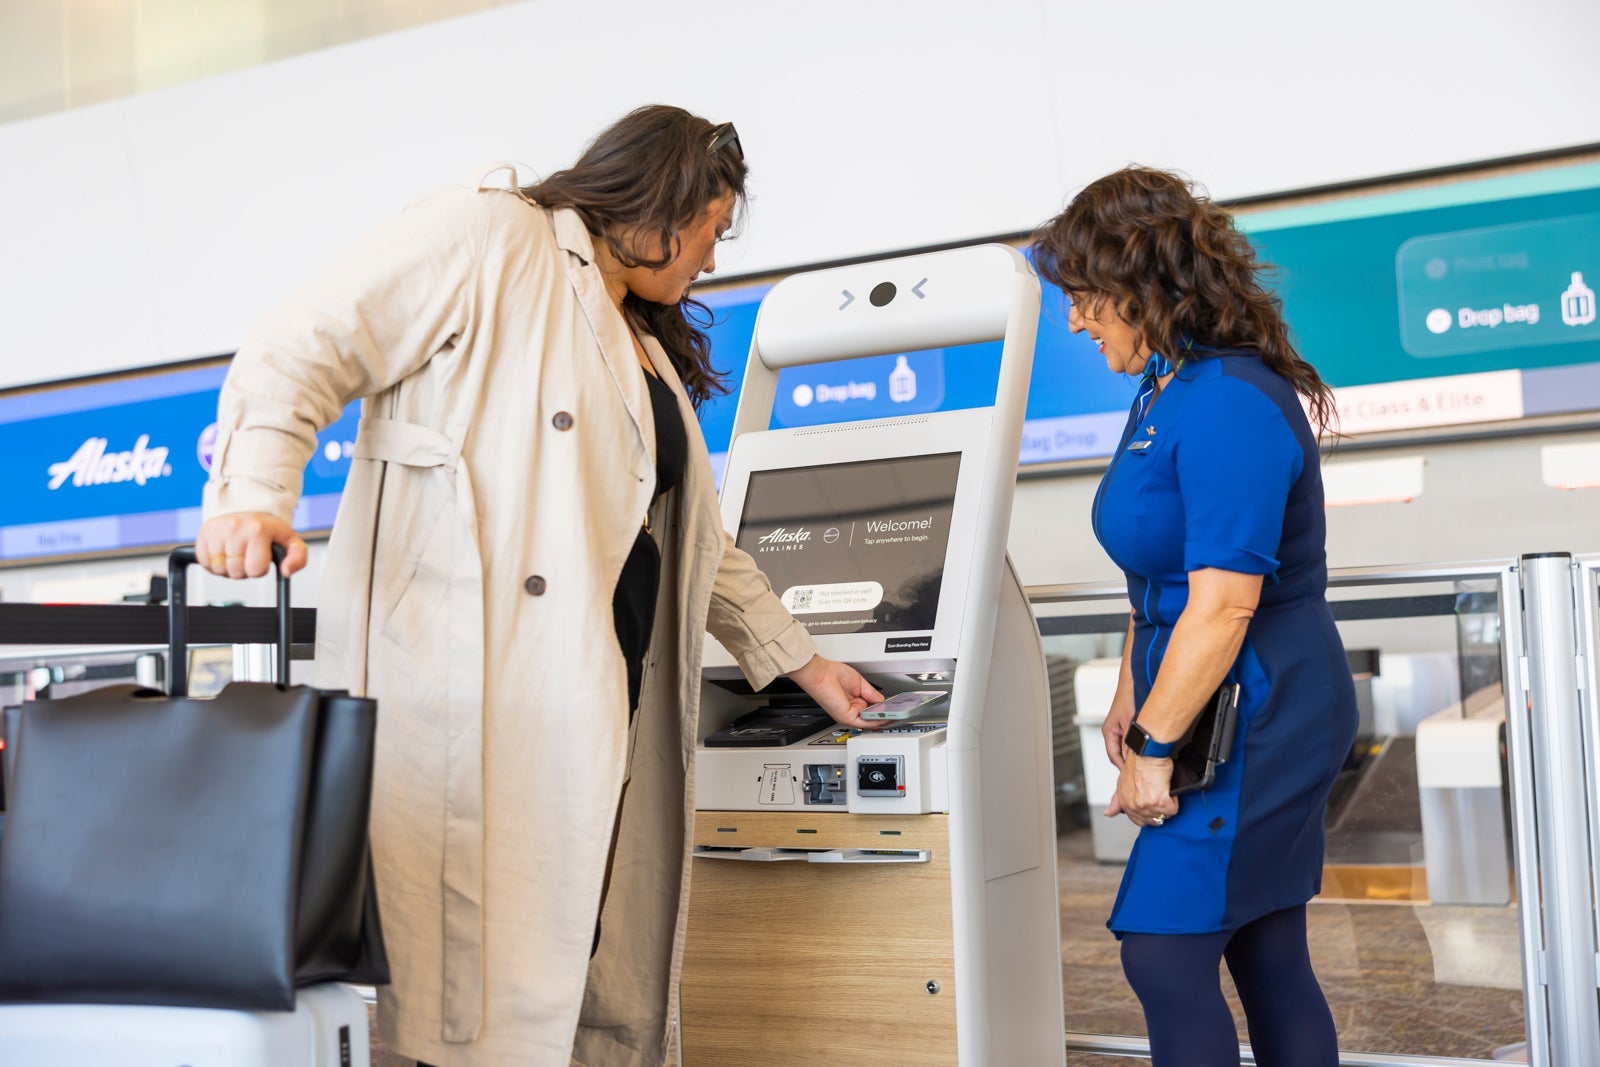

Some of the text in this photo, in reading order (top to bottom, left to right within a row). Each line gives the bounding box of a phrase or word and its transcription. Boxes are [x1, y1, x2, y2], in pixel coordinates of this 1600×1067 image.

[1458, 303, 1539, 328] Drop bag
[816, 381, 876, 403] Drop bag
[1419, 396, 1430, 411] &
[1435, 394, 1485, 410] Elite
[1054, 429, 1098, 450] Drop
[47, 433, 170, 490] Alaska
[867, 516, 933, 533] Welcome!
[757, 528, 810, 544] Alaska
[875, 536, 903, 544] anywhere
[912, 534, 929, 543] begin.
[759, 544, 805, 553] AIRLINES
